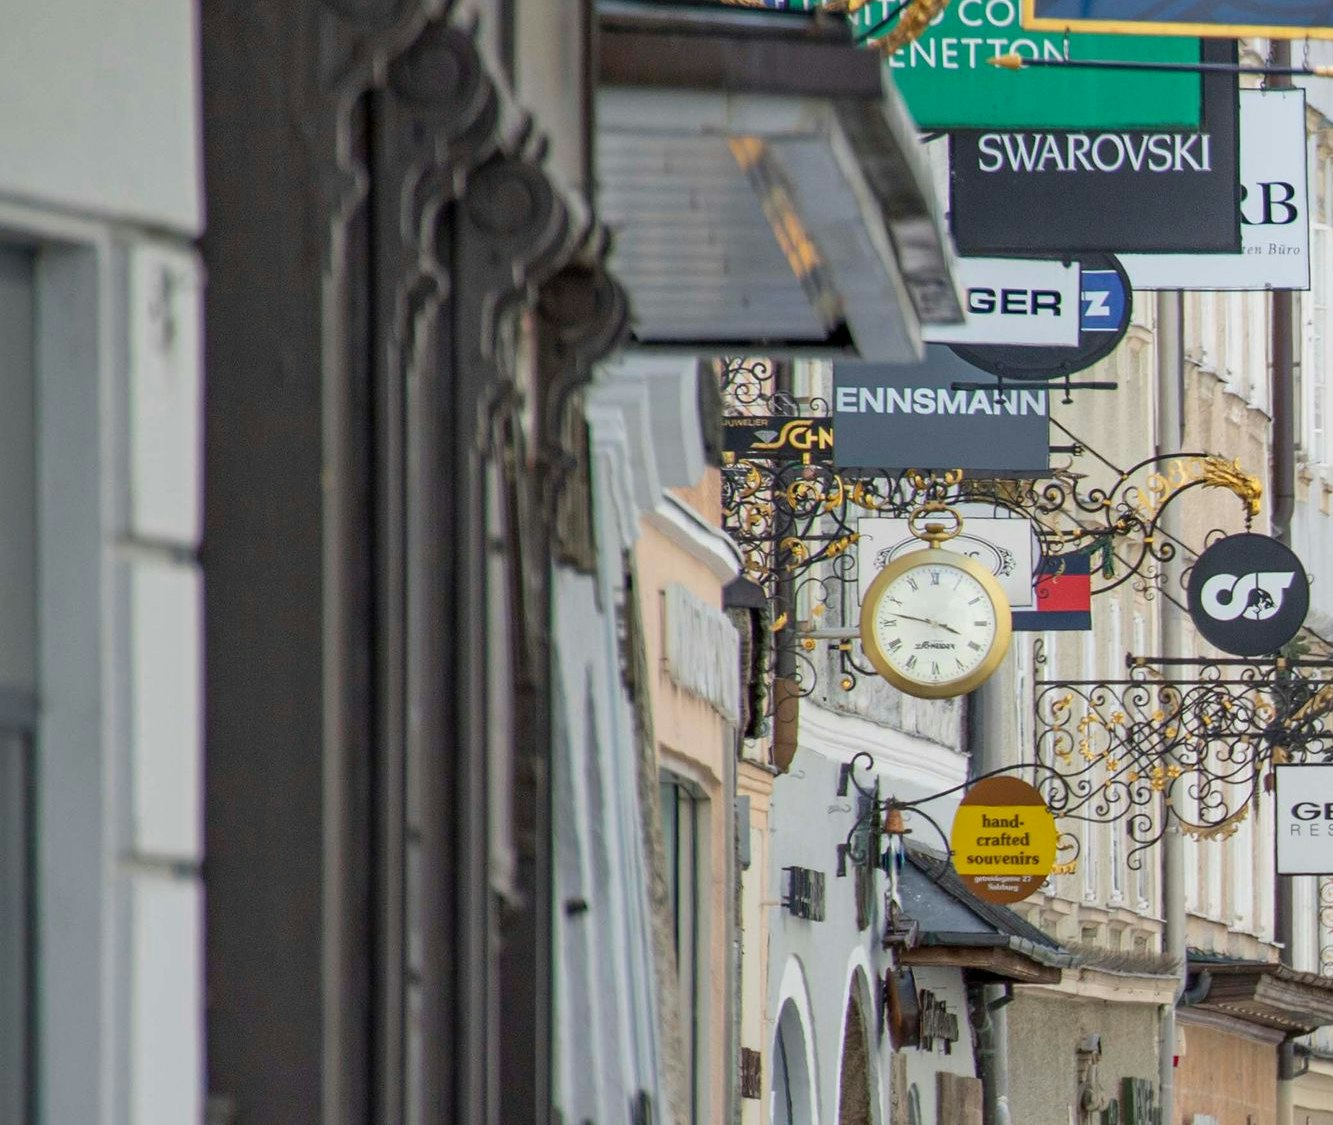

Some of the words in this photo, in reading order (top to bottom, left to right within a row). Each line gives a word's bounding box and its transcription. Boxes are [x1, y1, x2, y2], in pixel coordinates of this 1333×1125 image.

[978, 133, 1211, 173] SWAROVSKI
[1268, 243, 1300, 255] Büro
[982, 814, 1024, 828] hand-
[976, 832, 1030, 847] crafted
[967, 852, 1040, 865] souvenirs
